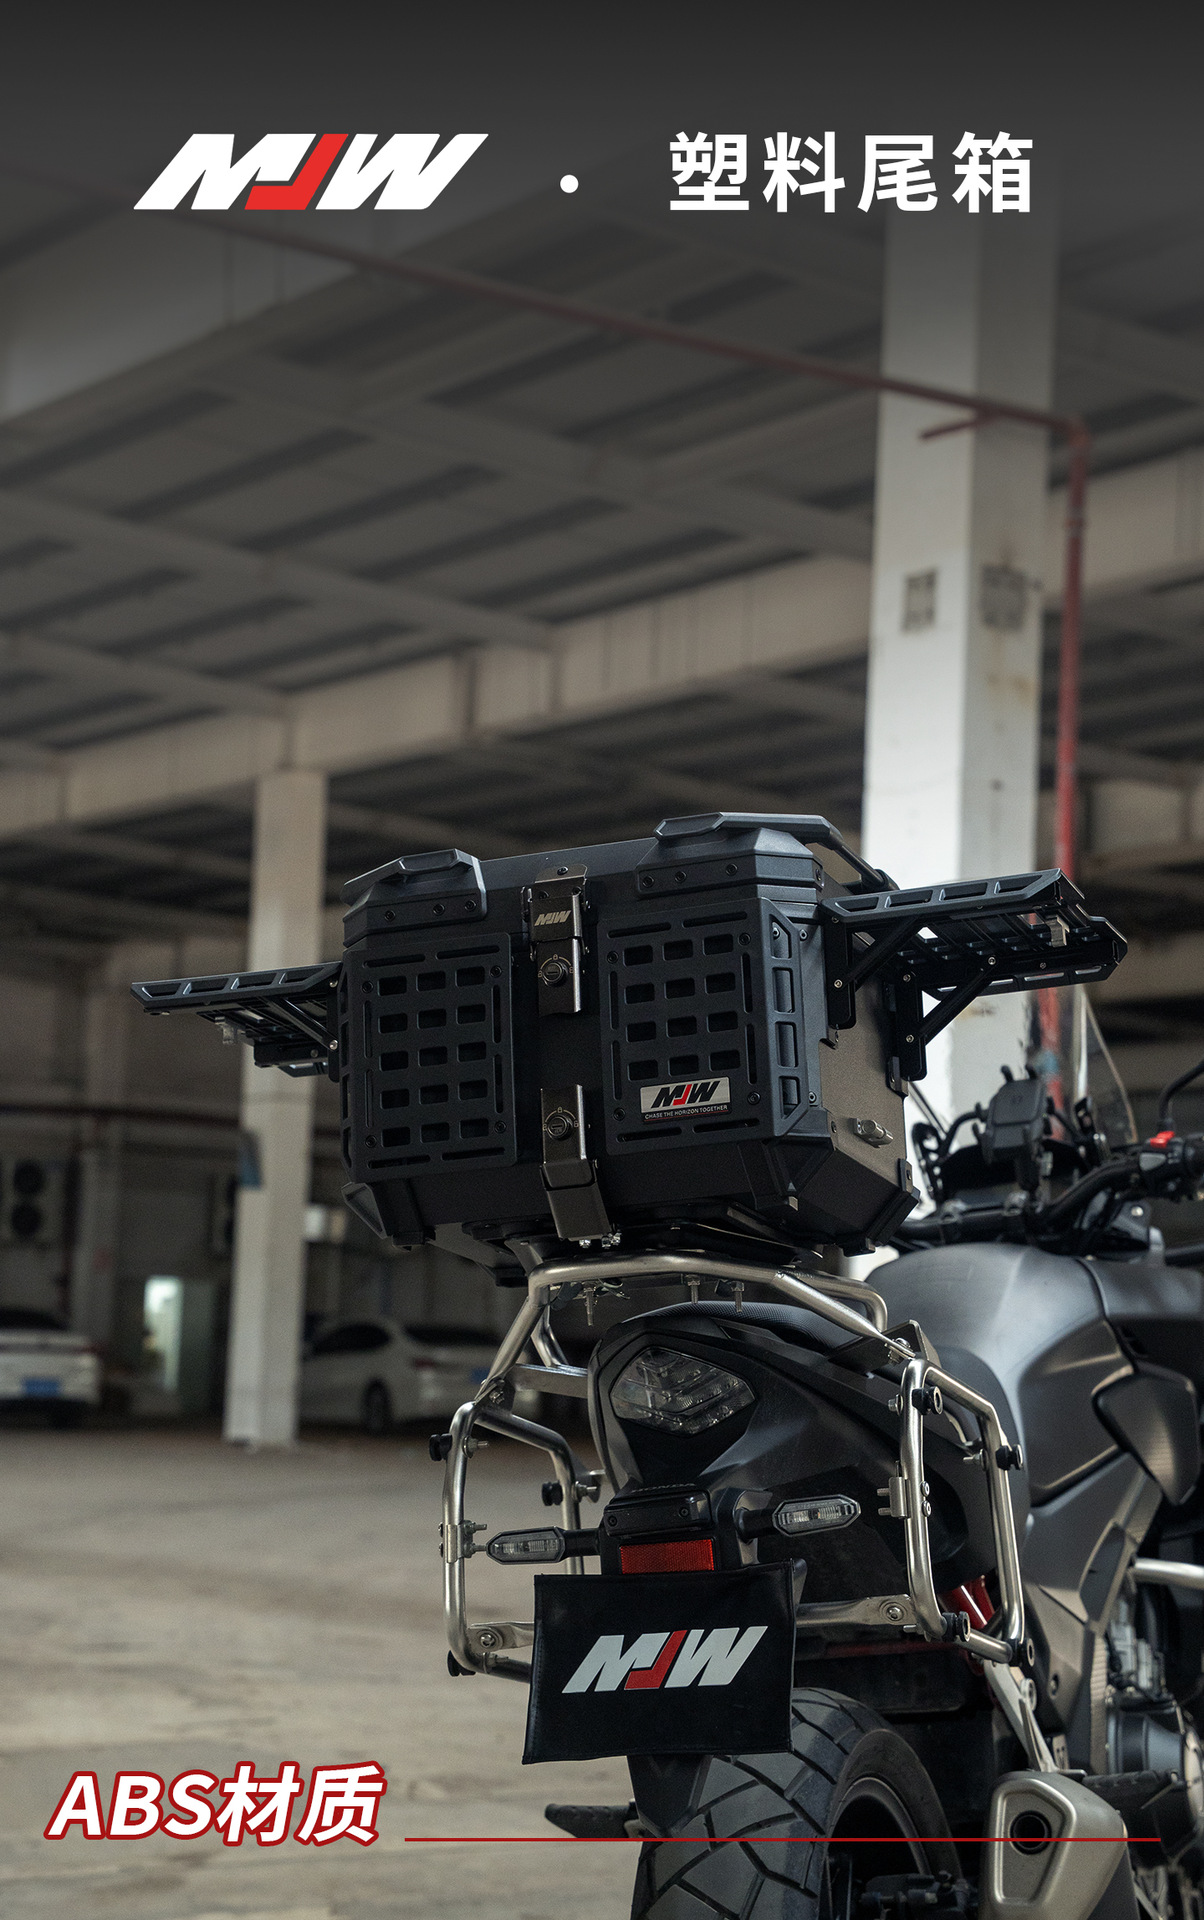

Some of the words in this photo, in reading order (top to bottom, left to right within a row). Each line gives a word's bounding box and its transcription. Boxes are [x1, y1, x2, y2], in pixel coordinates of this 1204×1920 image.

[651, 1081, 720, 1108] MJW
[675, 1108, 699, 1116] HORIZON
[700, 1104, 728, 1113] TOGETHER
[562, 1626, 768, 1693] MJW
